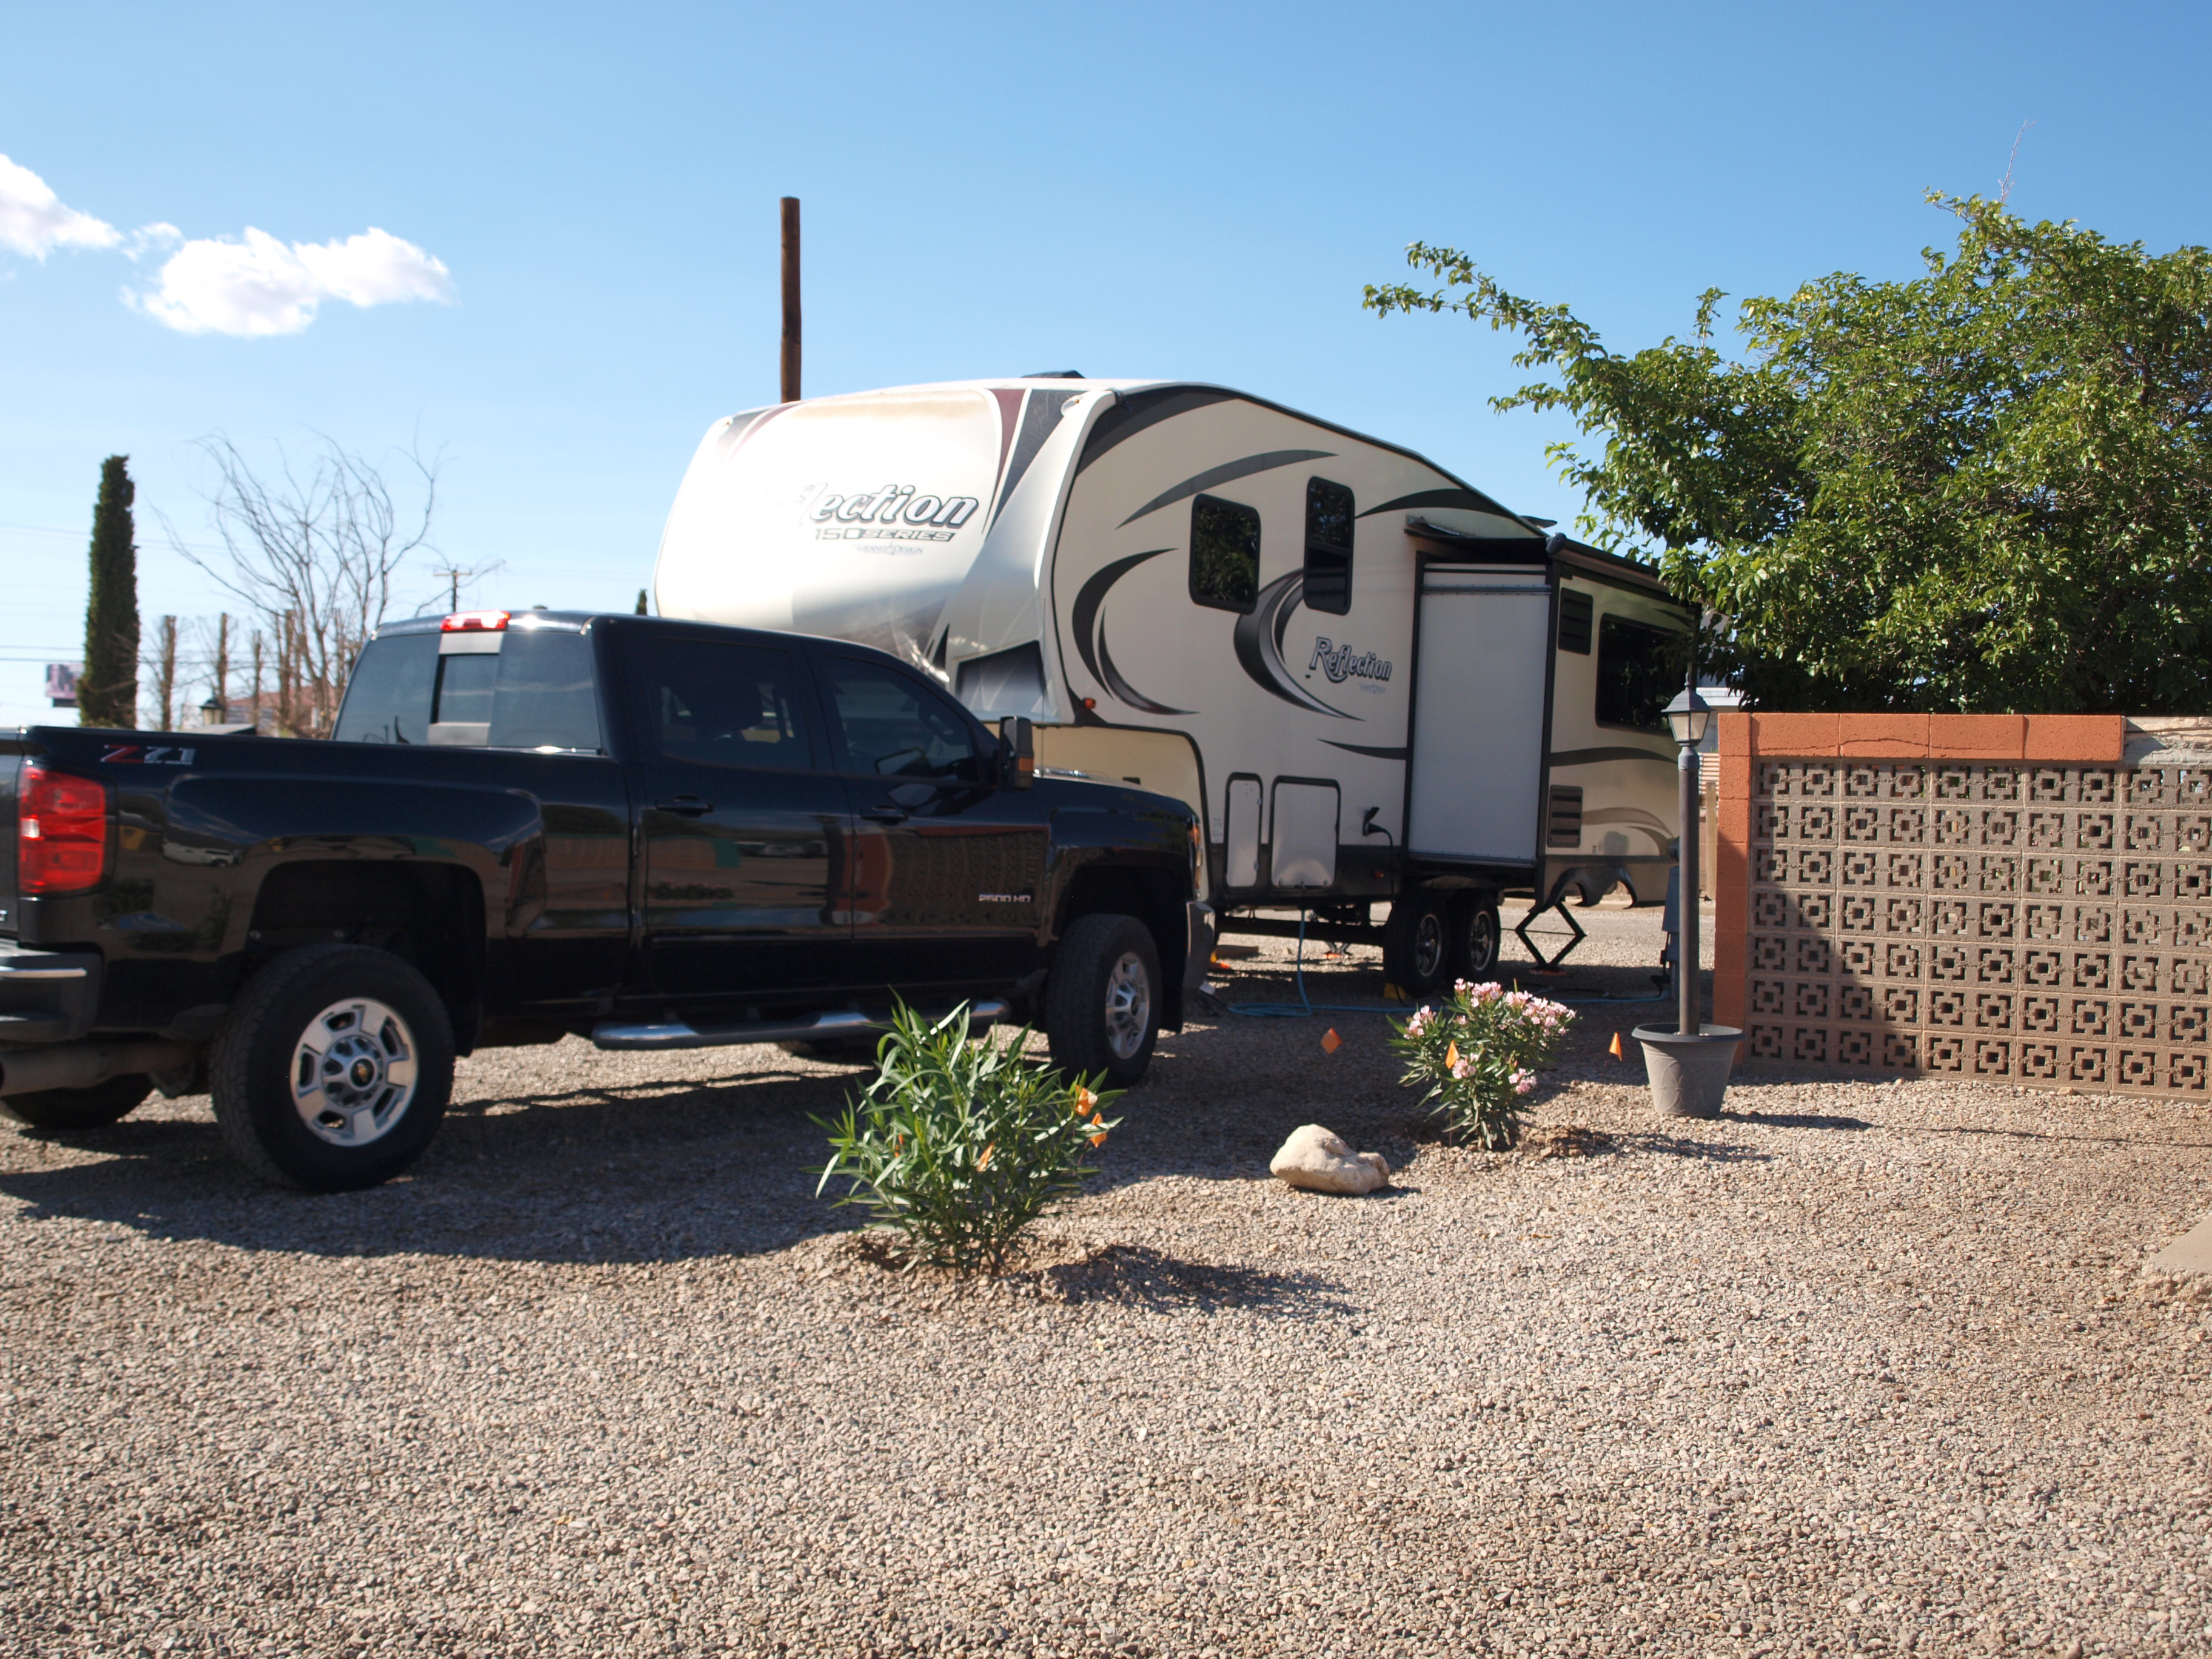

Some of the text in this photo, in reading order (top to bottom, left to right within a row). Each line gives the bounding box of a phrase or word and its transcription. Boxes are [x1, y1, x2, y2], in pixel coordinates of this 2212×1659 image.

[815, 528, 956, 541] 150 SERIES
[1309, 637, 1393, 684] Reflection
[100, 744, 196, 765] Z71
